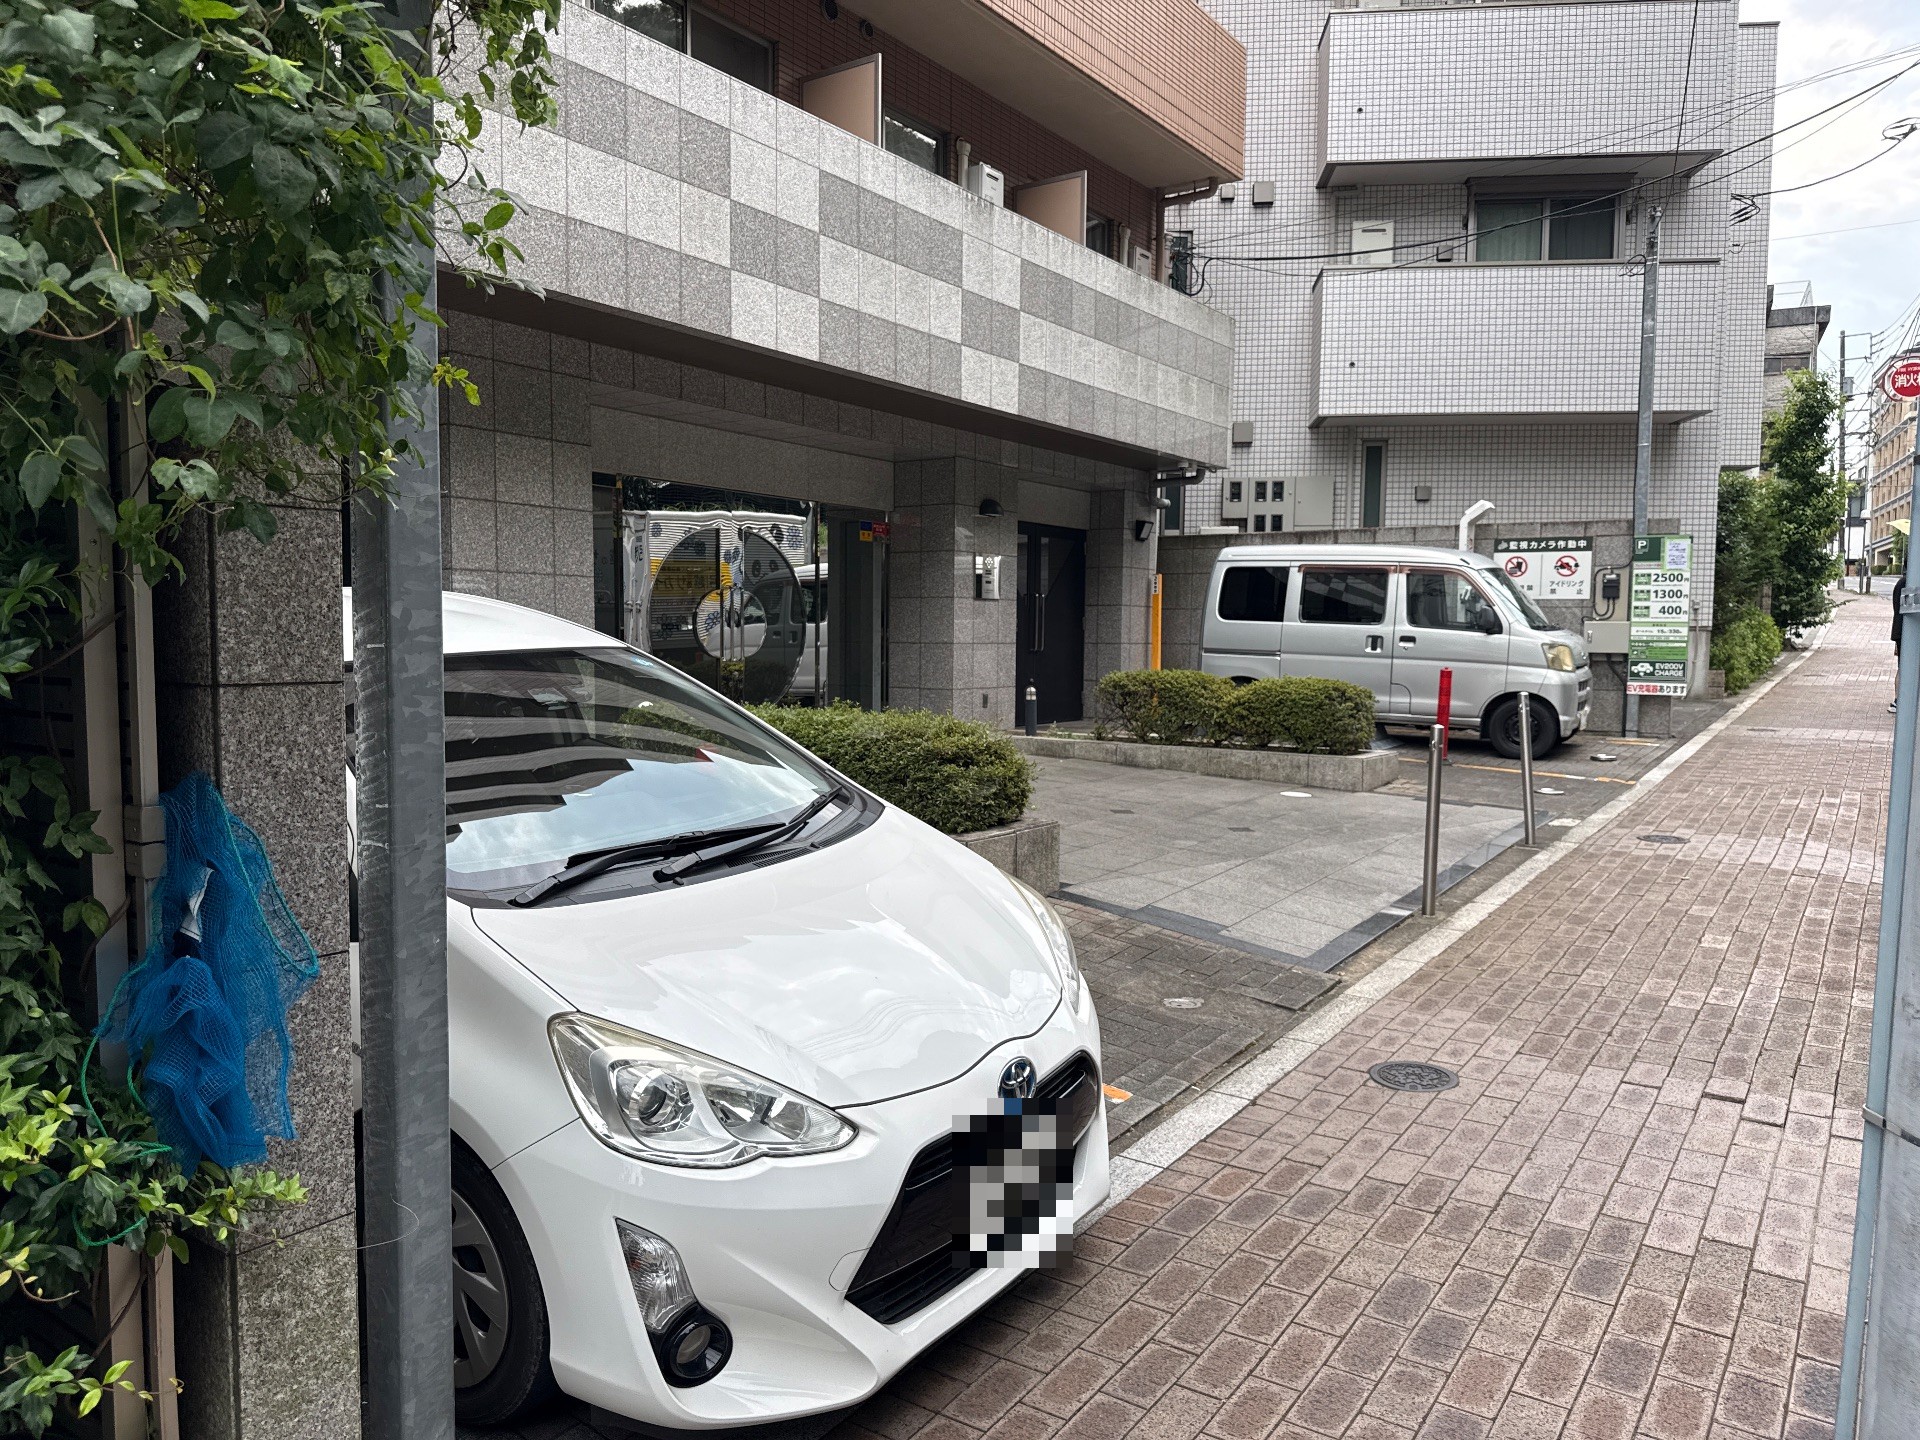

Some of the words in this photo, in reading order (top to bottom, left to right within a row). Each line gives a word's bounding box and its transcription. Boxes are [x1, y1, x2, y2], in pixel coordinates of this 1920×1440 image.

[1508, 539, 1588, 550] 監視カメラ作動中
[1637, 540, 1647, 550] P
[1549, 580, 1584, 588] アイドリング
[1655, 662, 1684, 670] EV200V
[1627, 684, 1687, 694] EV充電器あります
